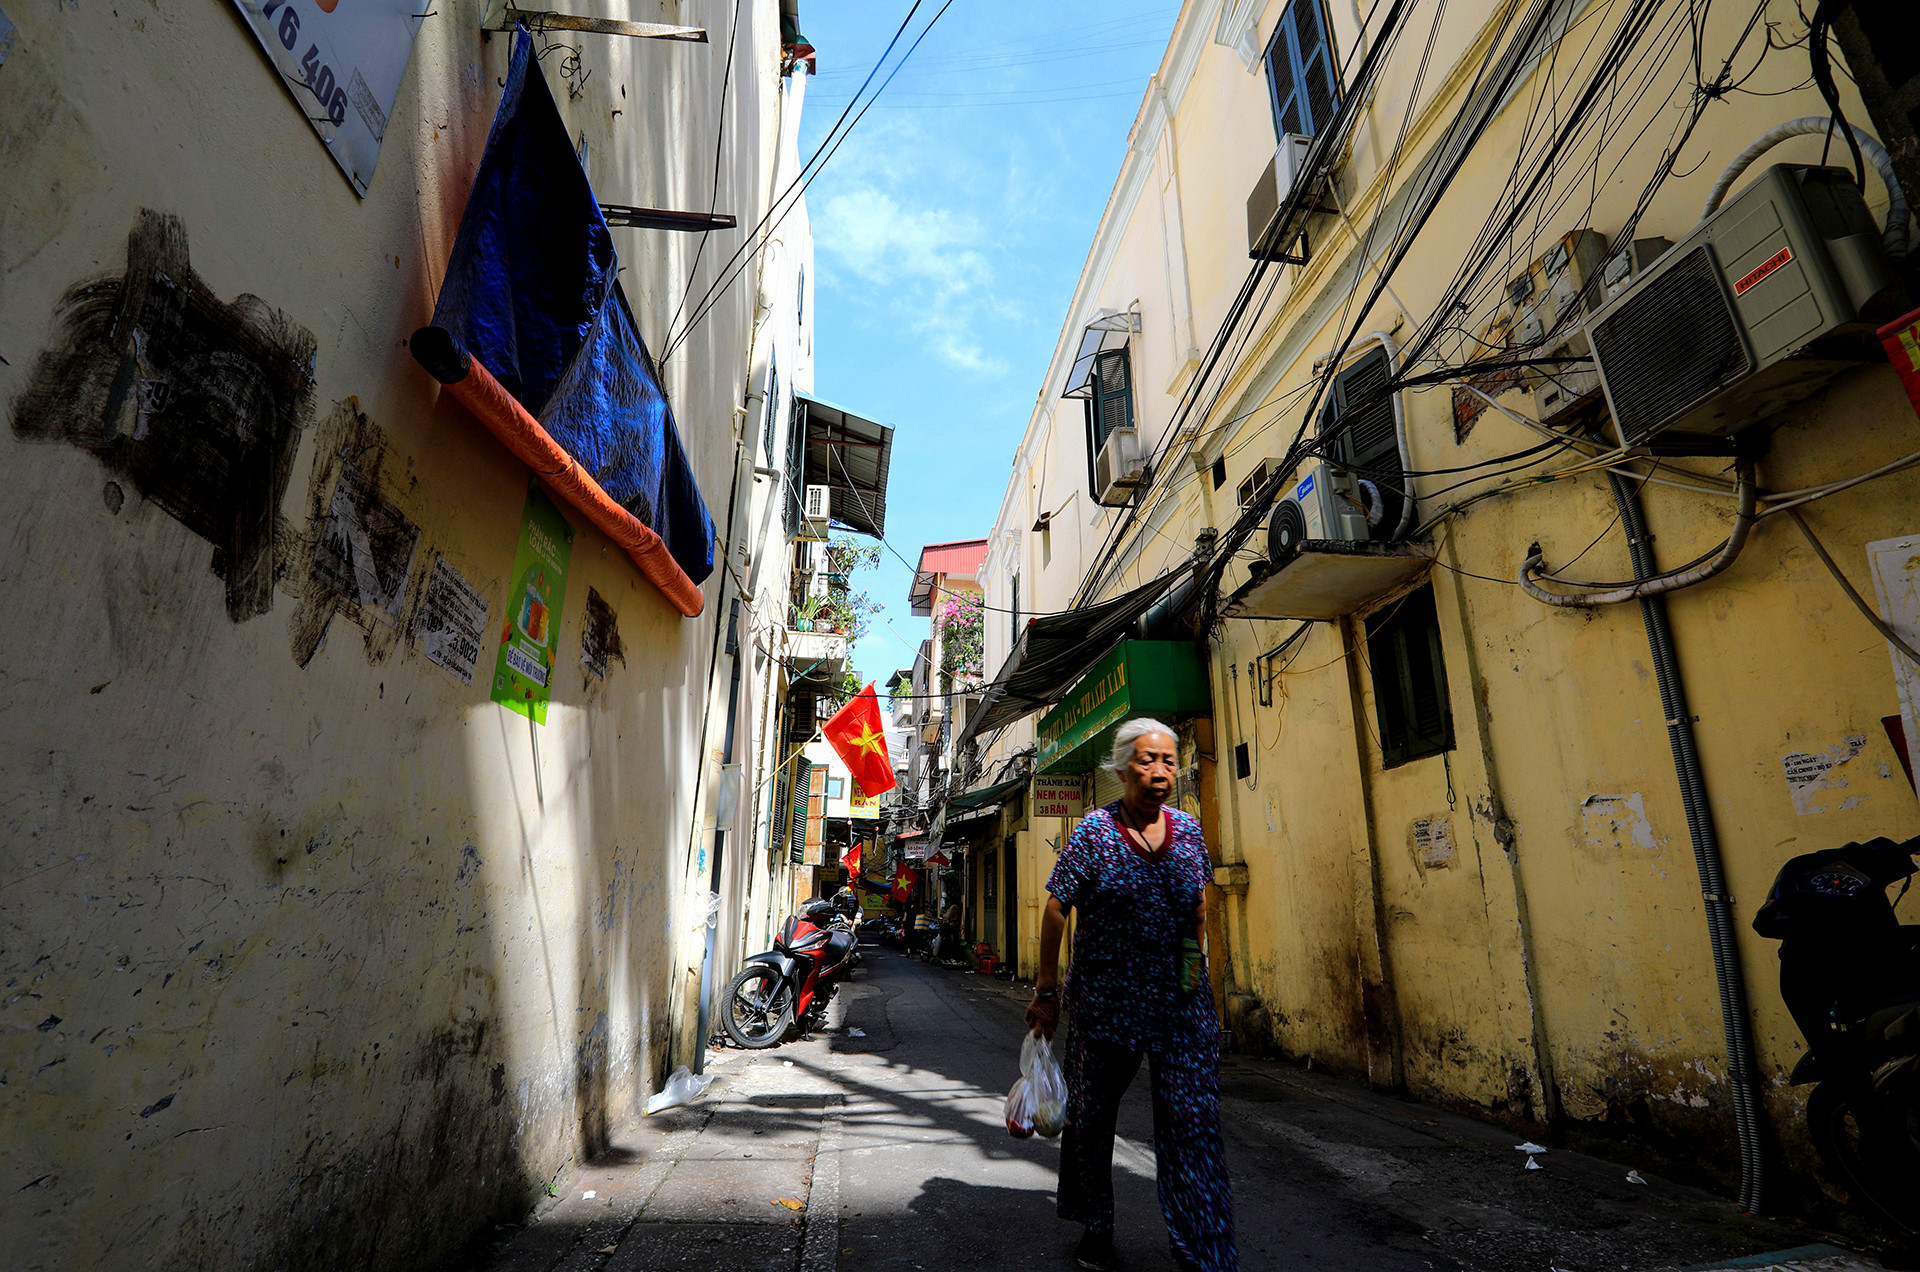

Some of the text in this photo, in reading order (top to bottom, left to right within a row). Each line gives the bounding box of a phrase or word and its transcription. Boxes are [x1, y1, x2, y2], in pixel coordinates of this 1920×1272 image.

[301, 43, 346, 127] 406
[1739, 253, 1786, 290] HITACHI
[1037, 777, 1063, 787] THÀNH
[1036, 790, 1082, 801] NEM CHUA
[1039, 803, 1068, 815] 38 RÁN
